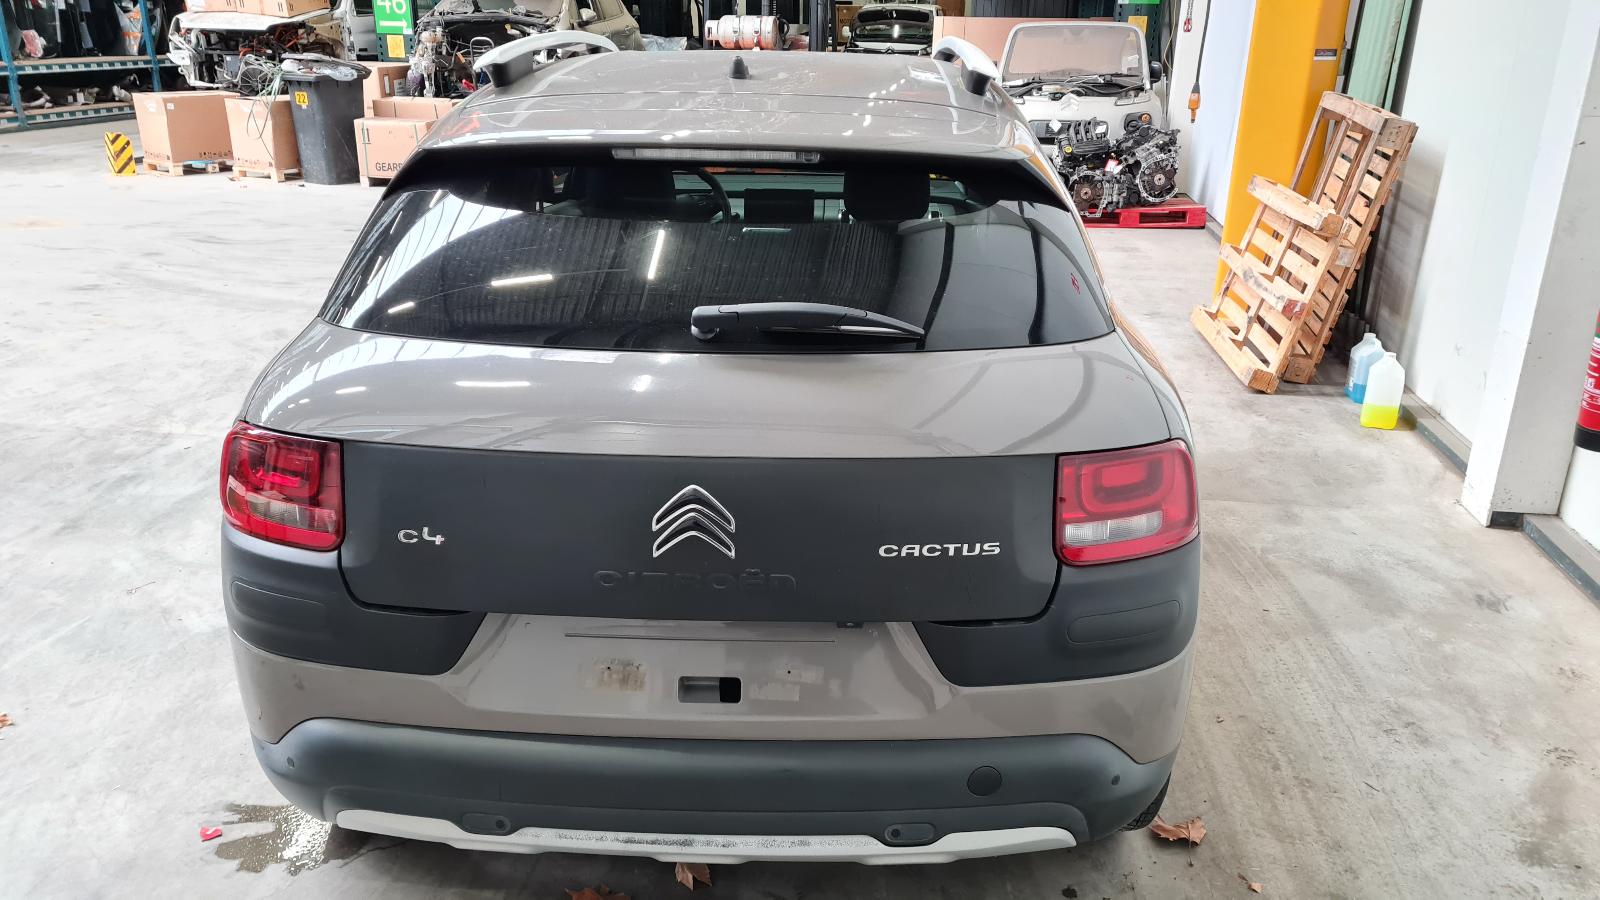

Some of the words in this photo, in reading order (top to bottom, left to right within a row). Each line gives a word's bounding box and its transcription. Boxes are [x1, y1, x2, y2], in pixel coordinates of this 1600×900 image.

[296, 93, 307, 103] 22
[397, 526, 445, 545] C4
[878, 542, 1001, 557] CACTUS
[593, 568, 797, 592] CITROËN
